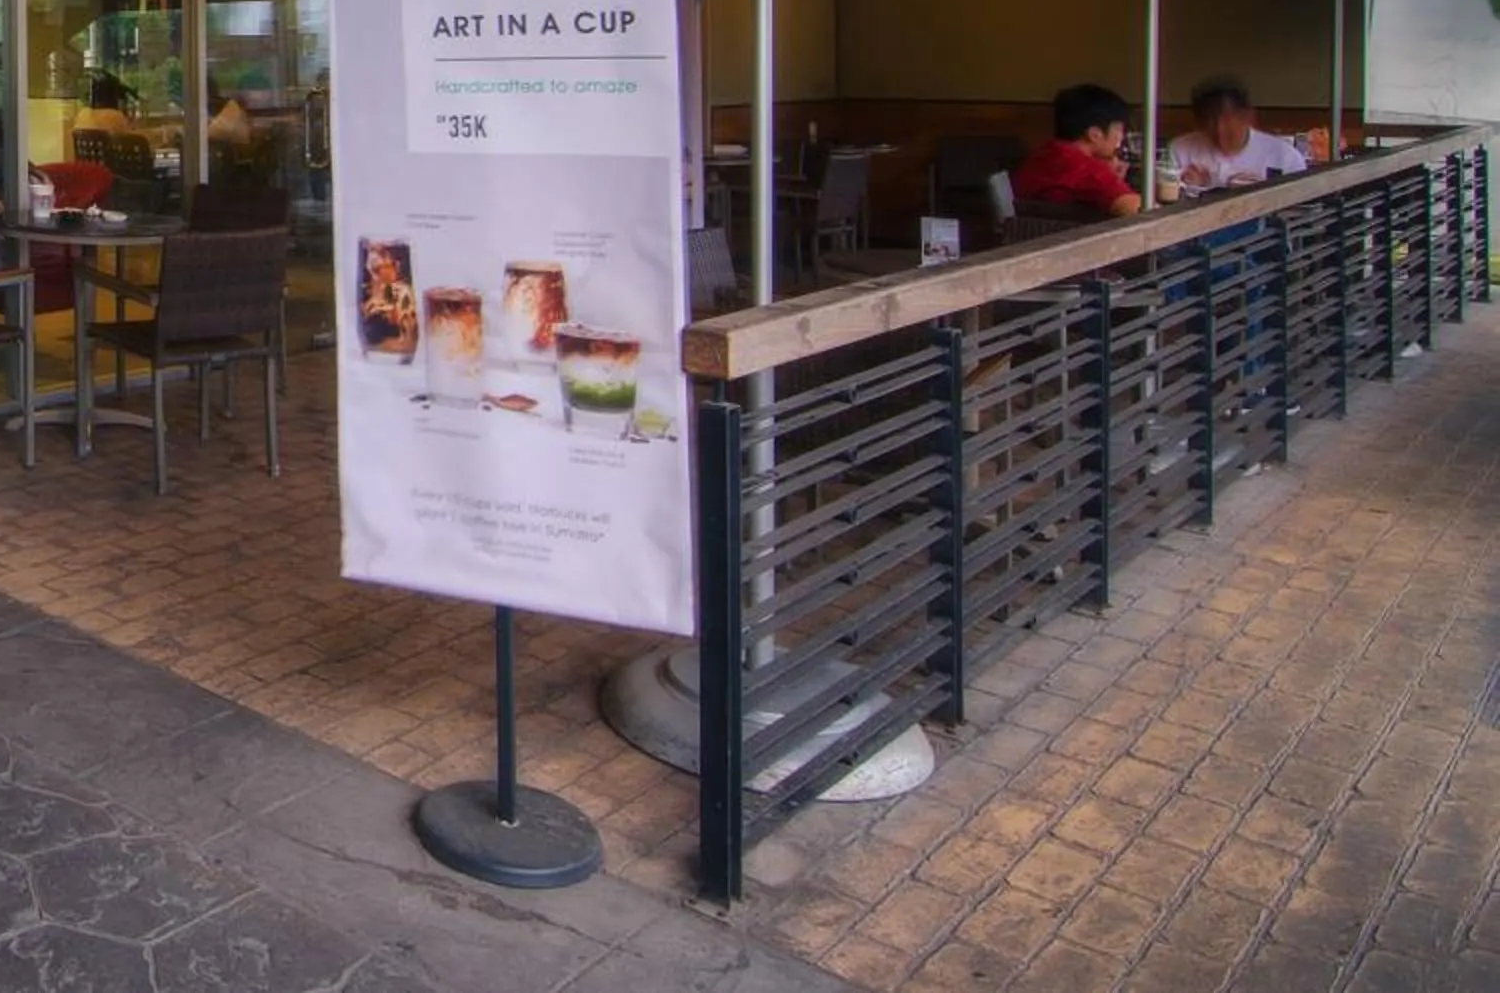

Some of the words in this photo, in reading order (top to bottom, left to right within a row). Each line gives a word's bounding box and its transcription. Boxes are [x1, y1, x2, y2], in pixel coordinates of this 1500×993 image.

[432, 15, 484, 38] ART
[498, 14, 527, 36] IN
[540, 12, 561, 35] A
[574, 10, 635, 34] CUP
[435, 79, 545, 94] Handcrafted
[551, 79, 568, 94] to
[573, 79, 638, 94] amaze
